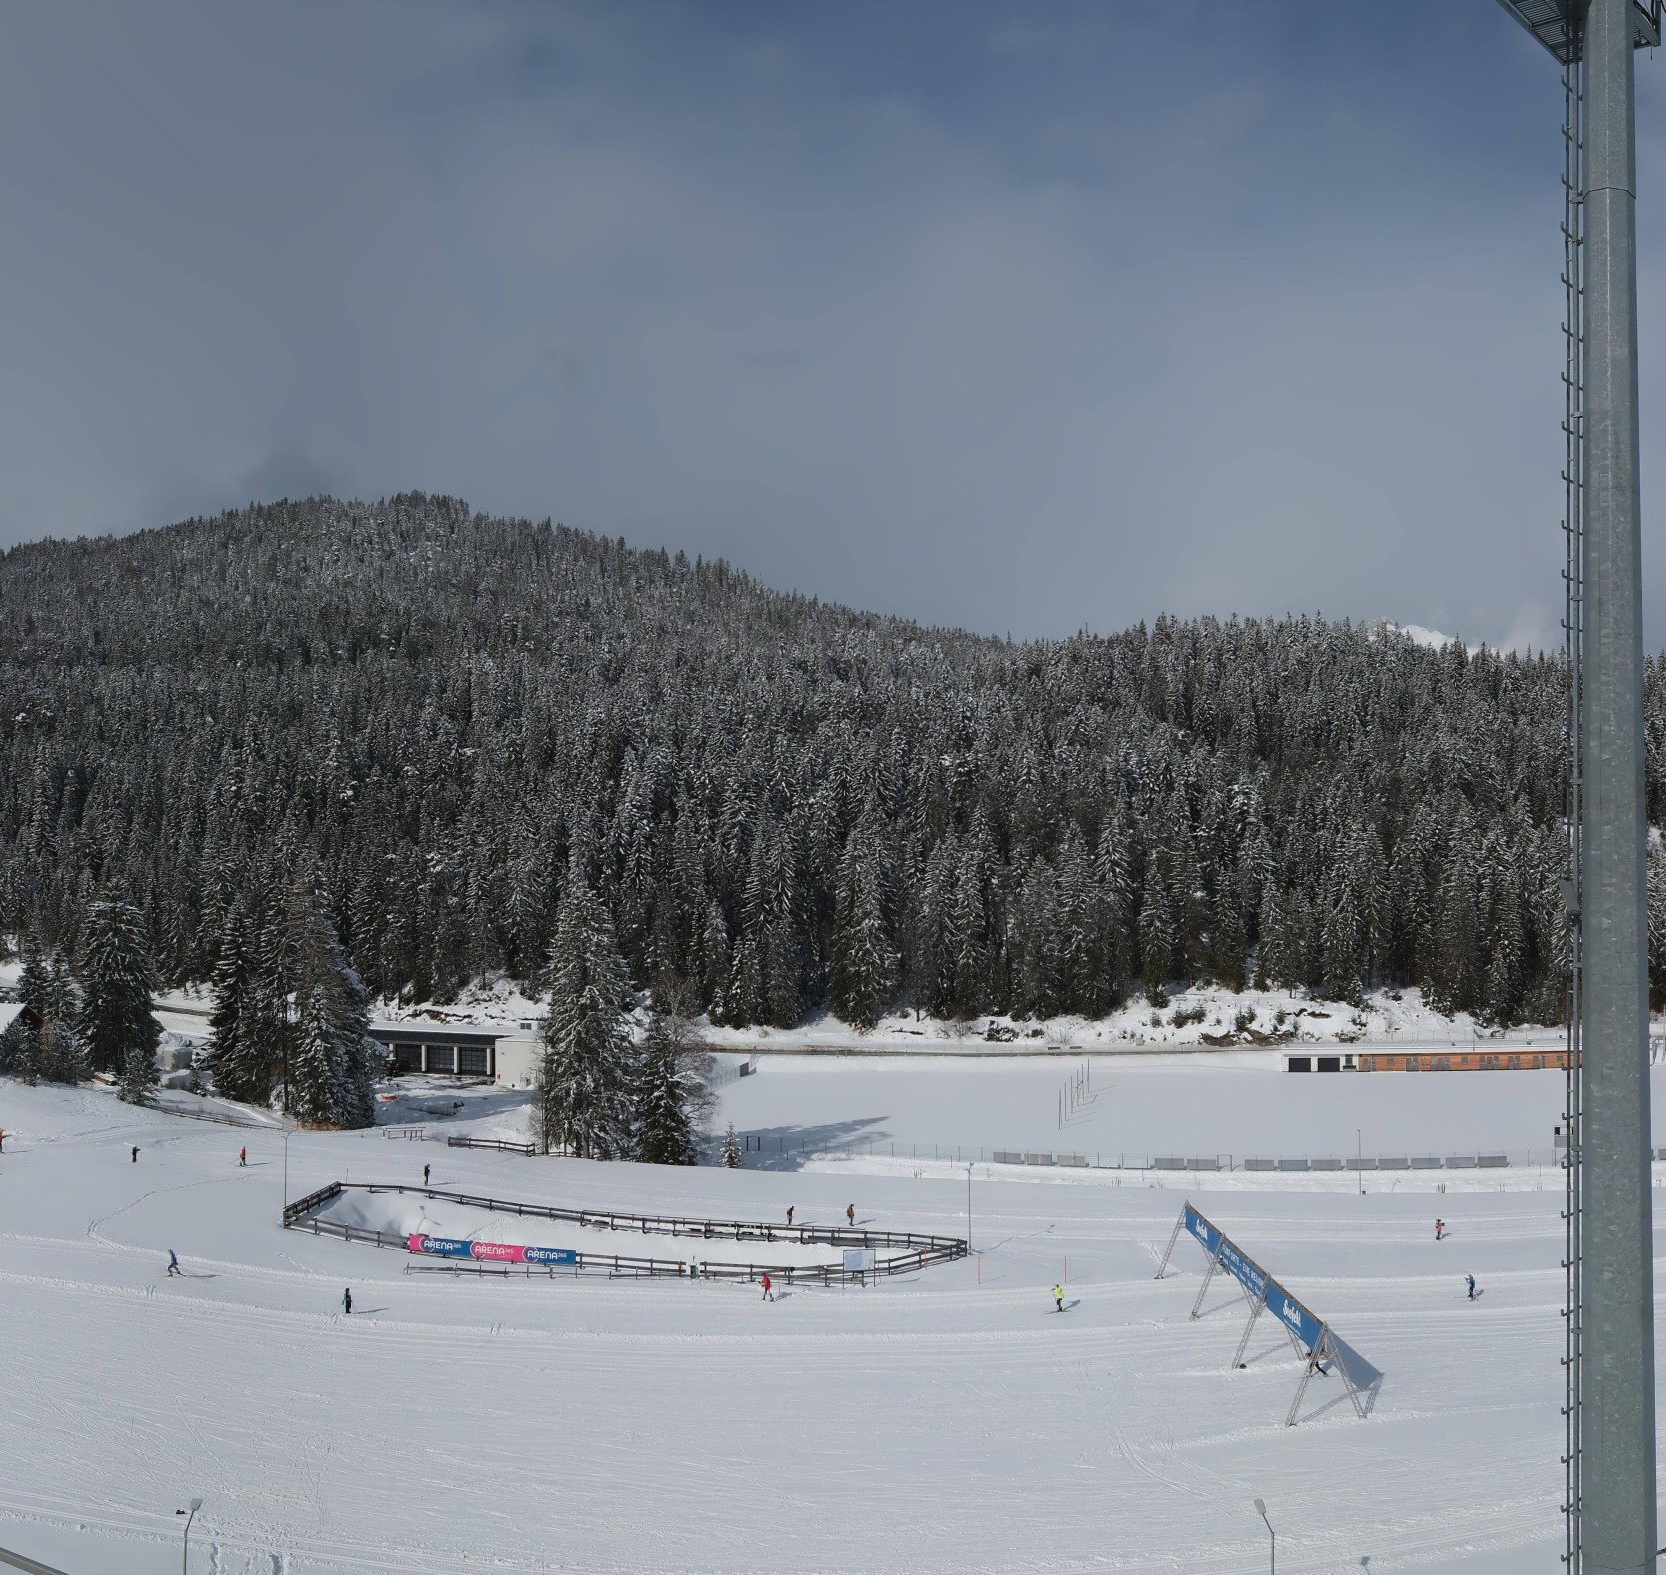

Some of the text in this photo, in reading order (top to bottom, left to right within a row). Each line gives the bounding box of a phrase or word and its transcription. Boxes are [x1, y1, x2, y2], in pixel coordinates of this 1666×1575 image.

[423, 1240, 453, 1250] ARENA
[475, 1246, 505, 1256] ARENA
[527, 1250, 558, 1260] ARENA
[1282, 1299, 1301, 1328] Seefeld
